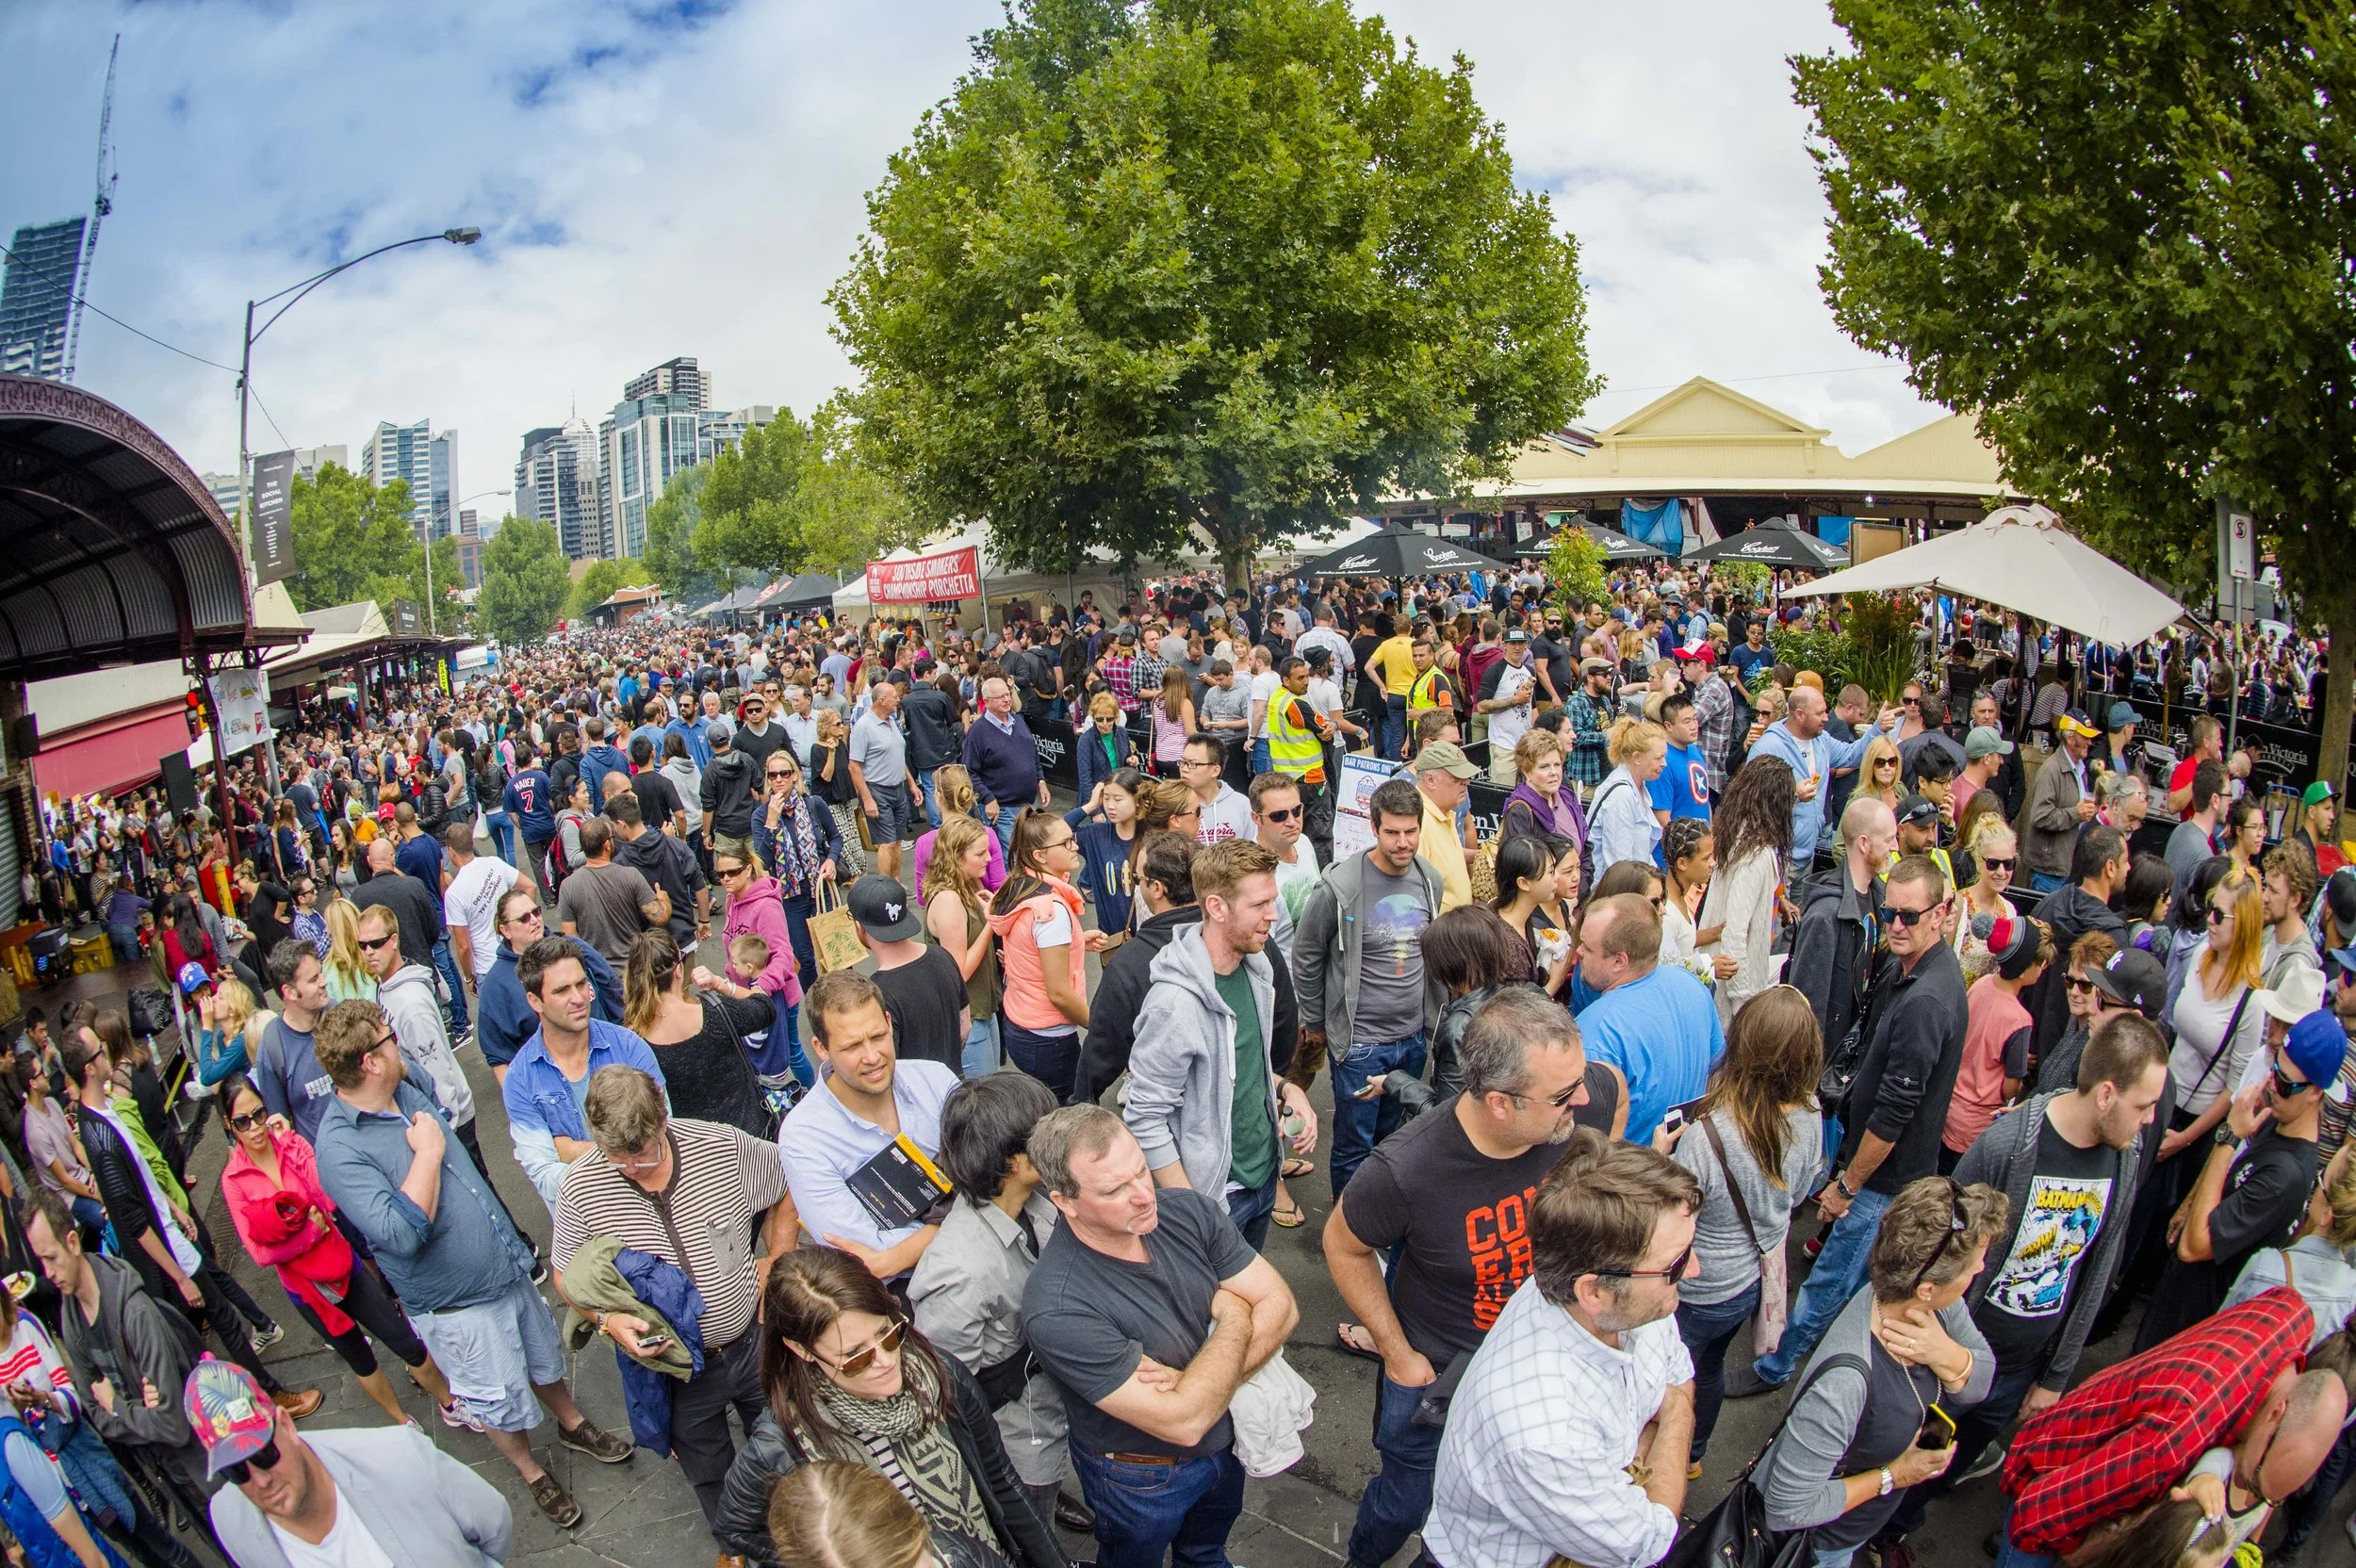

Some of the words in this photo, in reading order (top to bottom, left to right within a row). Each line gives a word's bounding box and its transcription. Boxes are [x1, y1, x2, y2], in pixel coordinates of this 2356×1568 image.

[266, 480, 279, 488] THE
[261, 488, 282, 499] SOCIAL
[259, 497, 283, 509] KITCHEN
[928, 573, 975, 597] PORCHETTA
[1032, 734, 1065, 752] Victoria
[2269, 743, 2308, 763] Victoria
[1344, 757, 1356, 767] BAR
[1356, 758, 1381, 772] PATRONS
[514, 777, 535, 792] MAUER
[520, 790, 534, 812] 7
[473, 868, 495, 906] DELIGHTFULLY
[478, 904, 487, 914] YET
[2035, 1189, 2086, 1210] BATMAN
